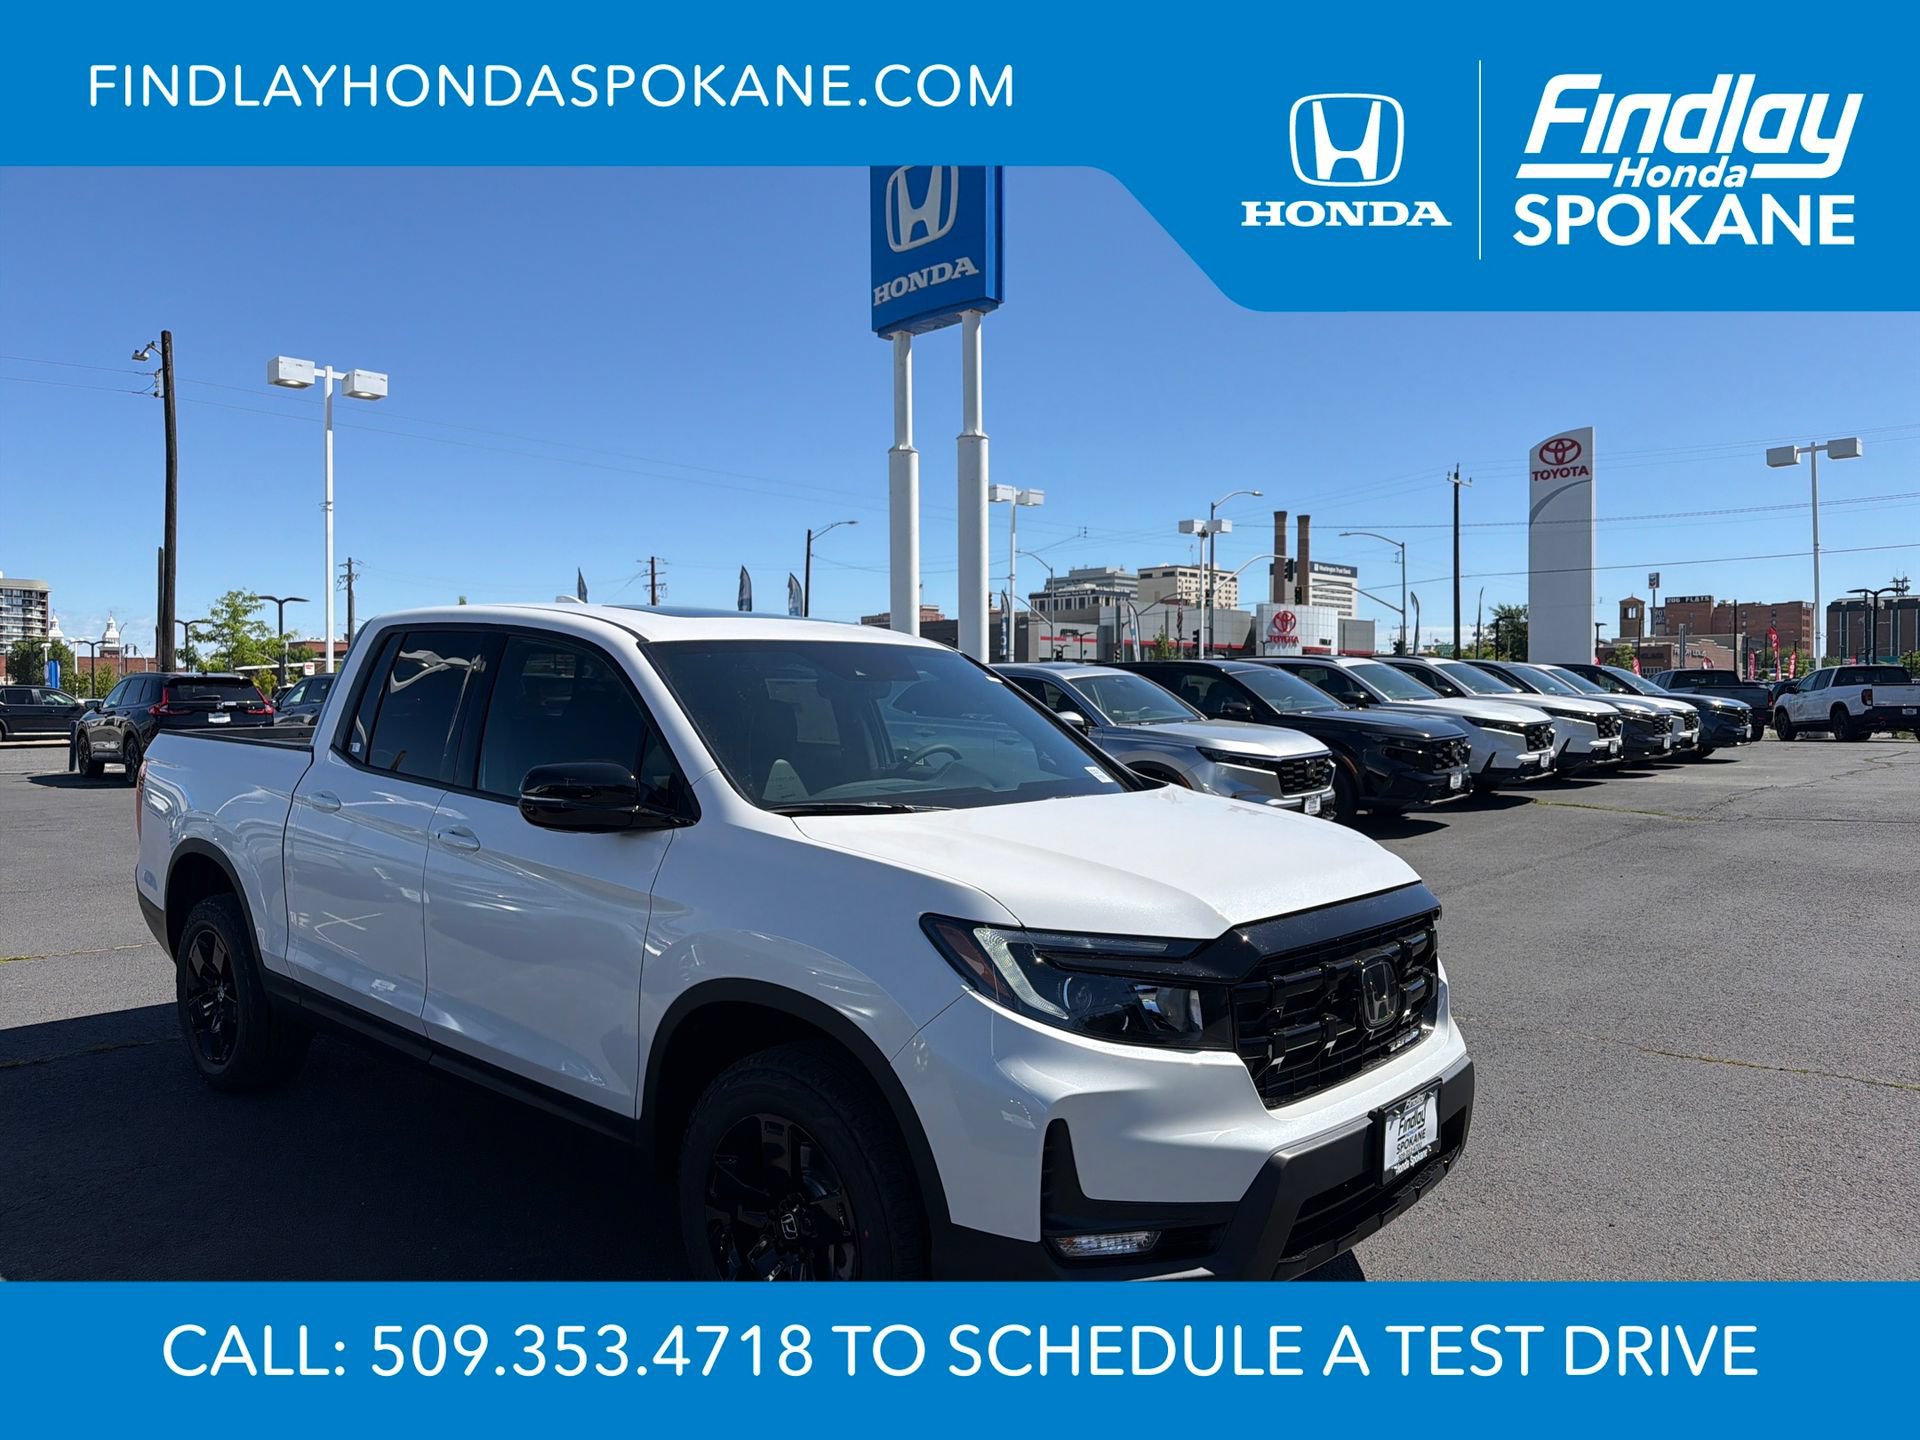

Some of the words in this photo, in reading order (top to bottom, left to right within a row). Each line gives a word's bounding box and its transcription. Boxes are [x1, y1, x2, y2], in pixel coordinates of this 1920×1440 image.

[872, 256, 980, 307] HONDA
[1531, 464, 1590, 481] TOYOTA
[1396, 1129, 1426, 1155] SPOKANE
